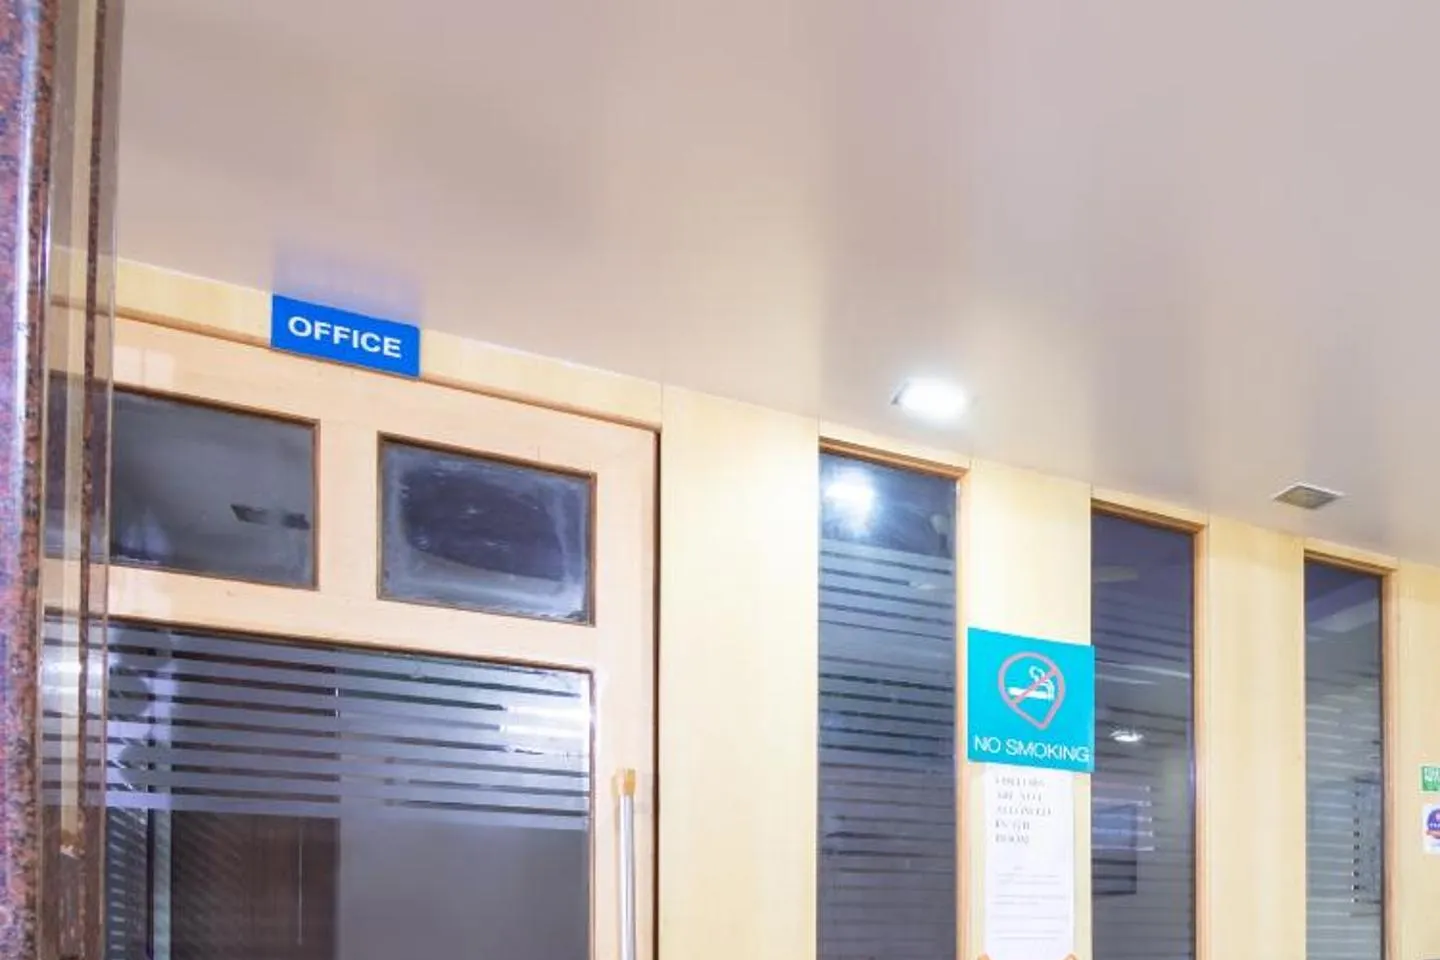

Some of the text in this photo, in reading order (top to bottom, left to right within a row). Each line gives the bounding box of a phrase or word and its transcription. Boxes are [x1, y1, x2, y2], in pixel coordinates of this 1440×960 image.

[288, 316, 402, 358] OFFICE
[974, 735, 1090, 763] NO SMOKING
